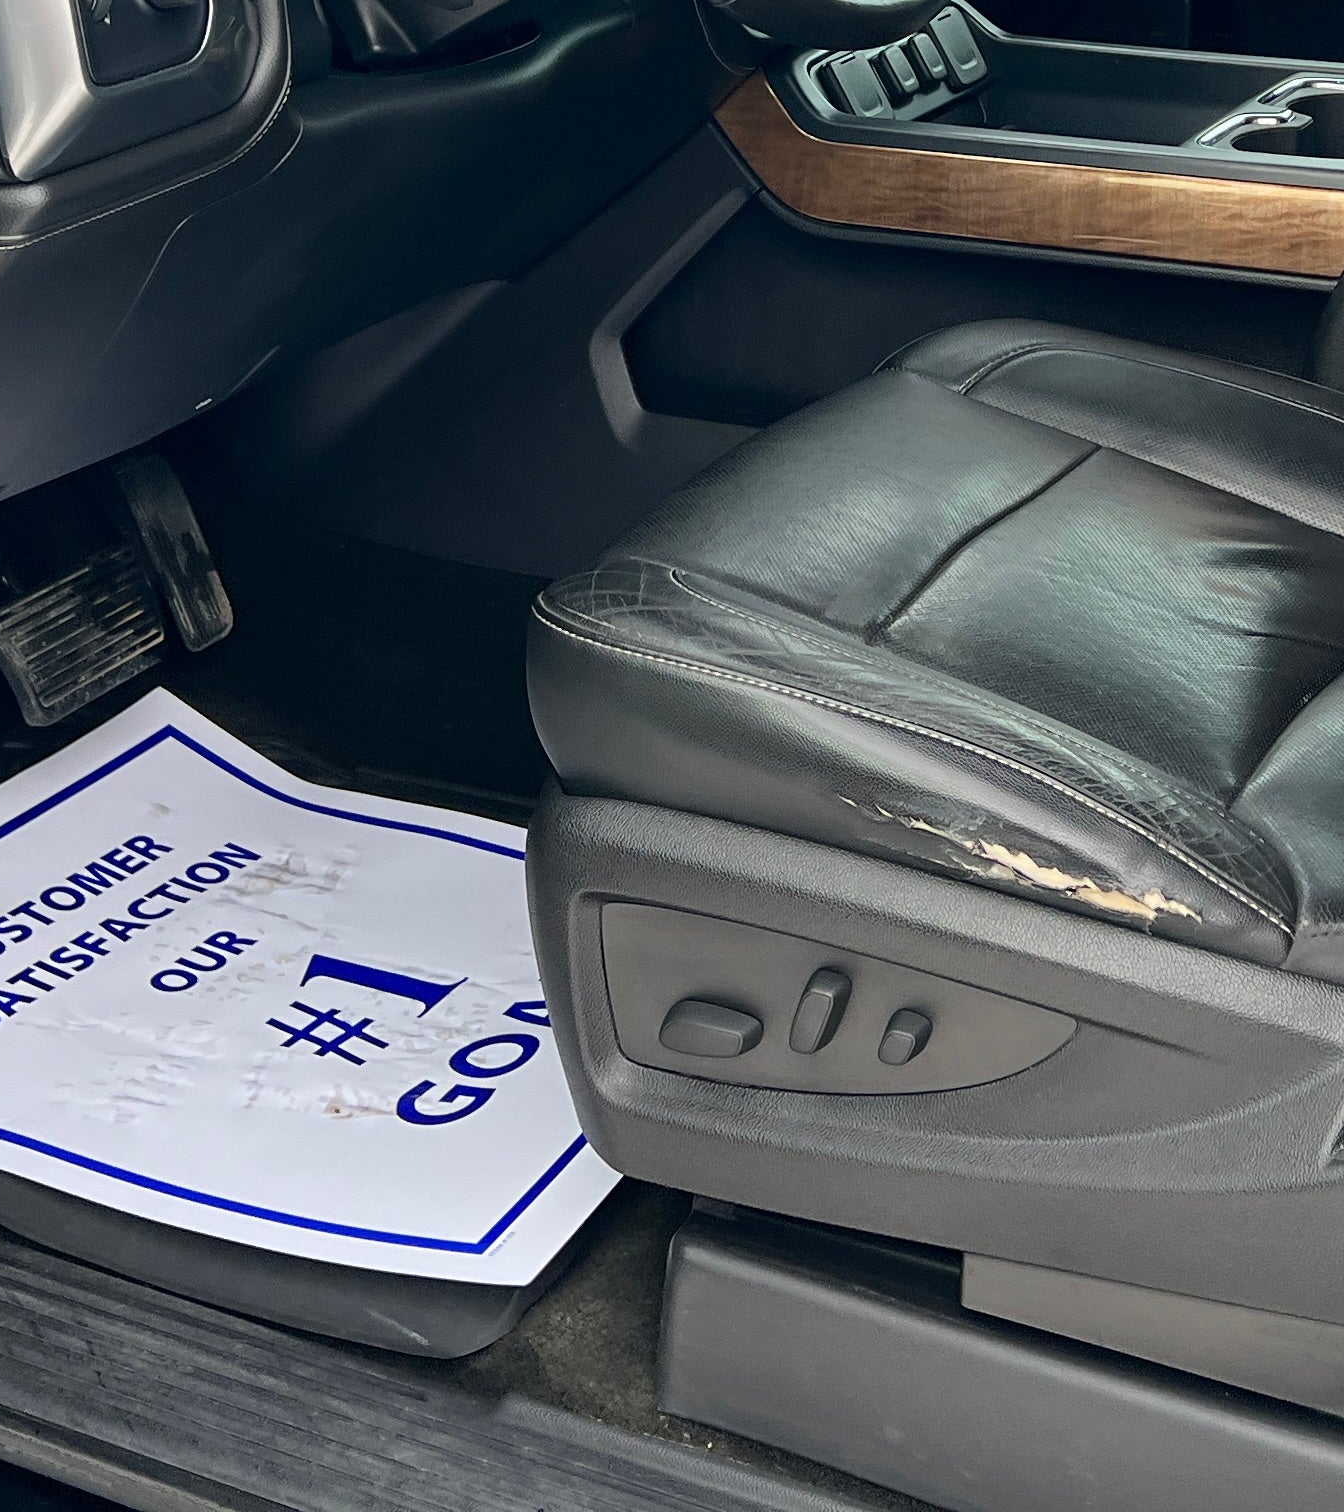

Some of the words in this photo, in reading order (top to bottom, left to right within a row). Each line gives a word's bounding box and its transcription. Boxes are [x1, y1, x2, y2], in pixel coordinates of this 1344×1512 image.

[149, 929, 259, 994] OUR
[265, 953, 468, 1067] #1
[395, 997, 553, 1126] GOA
